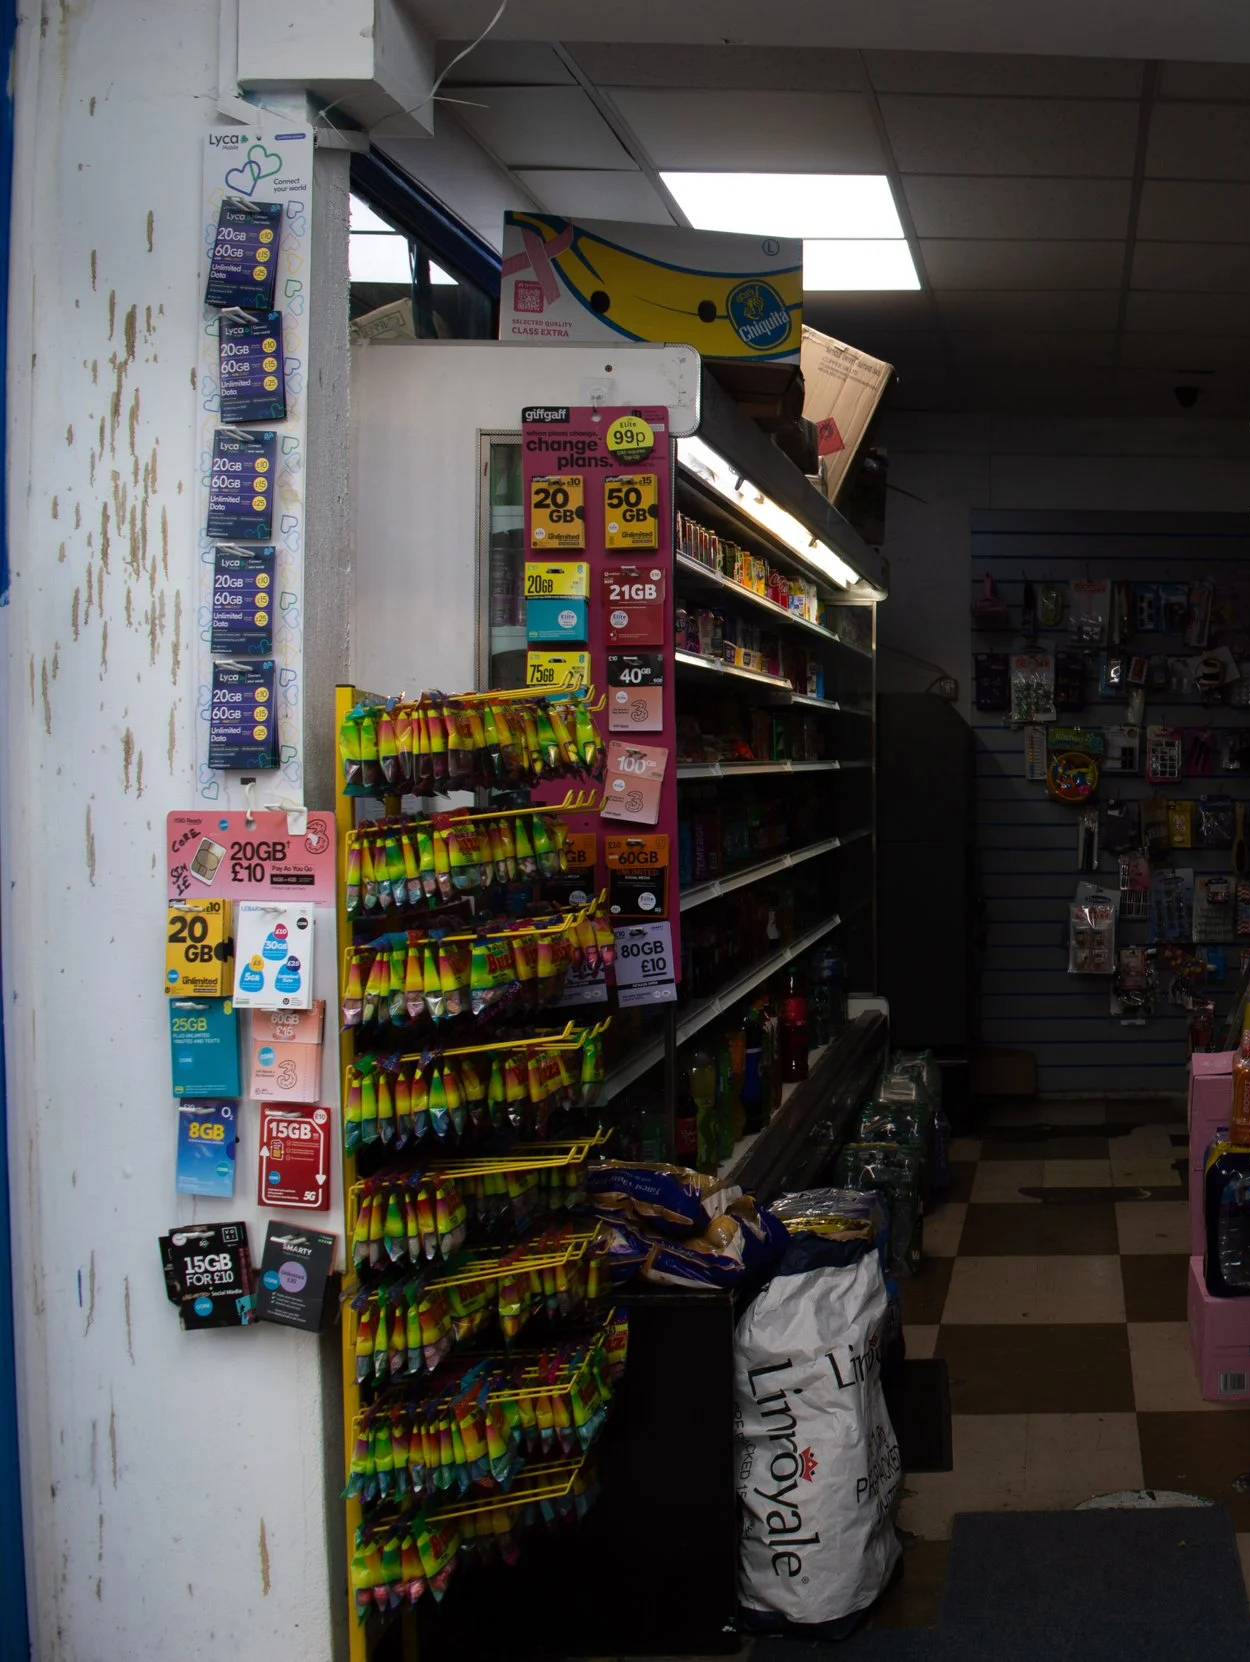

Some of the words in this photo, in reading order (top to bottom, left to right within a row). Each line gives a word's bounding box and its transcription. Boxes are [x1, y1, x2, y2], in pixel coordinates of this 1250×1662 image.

[208, 133, 240, 147] Lyca
[273, 177, 301, 186] Connect
[290, 183, 307, 192] world
[217, 227, 247, 242] 20GB
[214, 244, 244, 258] 60GB
[209, 270, 227, 280] Data
[211, 263, 242, 273] Unlimited
[512, 327, 539, 336] CLASS
[540, 328, 569, 337] EXTRA
[544, 320, 573, 328] QUALITY
[738, 308, 791, 343] Chiquita
[220, 344, 249, 357] 20GB
[525, 409, 567, 421] giffgaff
[526, 438, 598, 454] change
[613, 430, 646, 446] 99p
[557, 453, 613, 470] plans.
[533, 487, 570, 509] 20
[607, 487, 642, 509] 50
[548, 508, 575, 523] GB
[622, 508, 648, 523] GB
[527, 575, 554, 593] 20GB
[609, 583, 657, 600] 21GB
[529, 664, 554, 683] 75GB
[619, 667, 652, 684] 40GB
[617, 754, 657, 774] 100GB
[618, 849, 659, 865] 60GB
[231, 863, 265, 882] £10
[168, 915, 209, 944] 20
[184, 943, 214, 963] GB
[264, 940, 288, 950] 30GB
[621, 941, 665, 958] 80GB
[641, 957, 667, 974] £10
[243, 974, 260, 982] 5GB
[172, 1017, 207, 1032] 25GB
[270, 1013, 300, 1025] 60GB
[188, 1122, 226, 1140] 8GB
[269, 1121, 312, 1140] 15GB
[302, 1191, 316, 1200] 5G
[282, 1242, 313, 1256] SMARTY
[184, 1253, 233, 1274] 15GB
[186, 1273, 211, 1287] FOR
[213, 1270, 234, 1284] £10
[211, 1289, 226, 1297] Social
[747, 1358, 821, 1578] Linroyale
